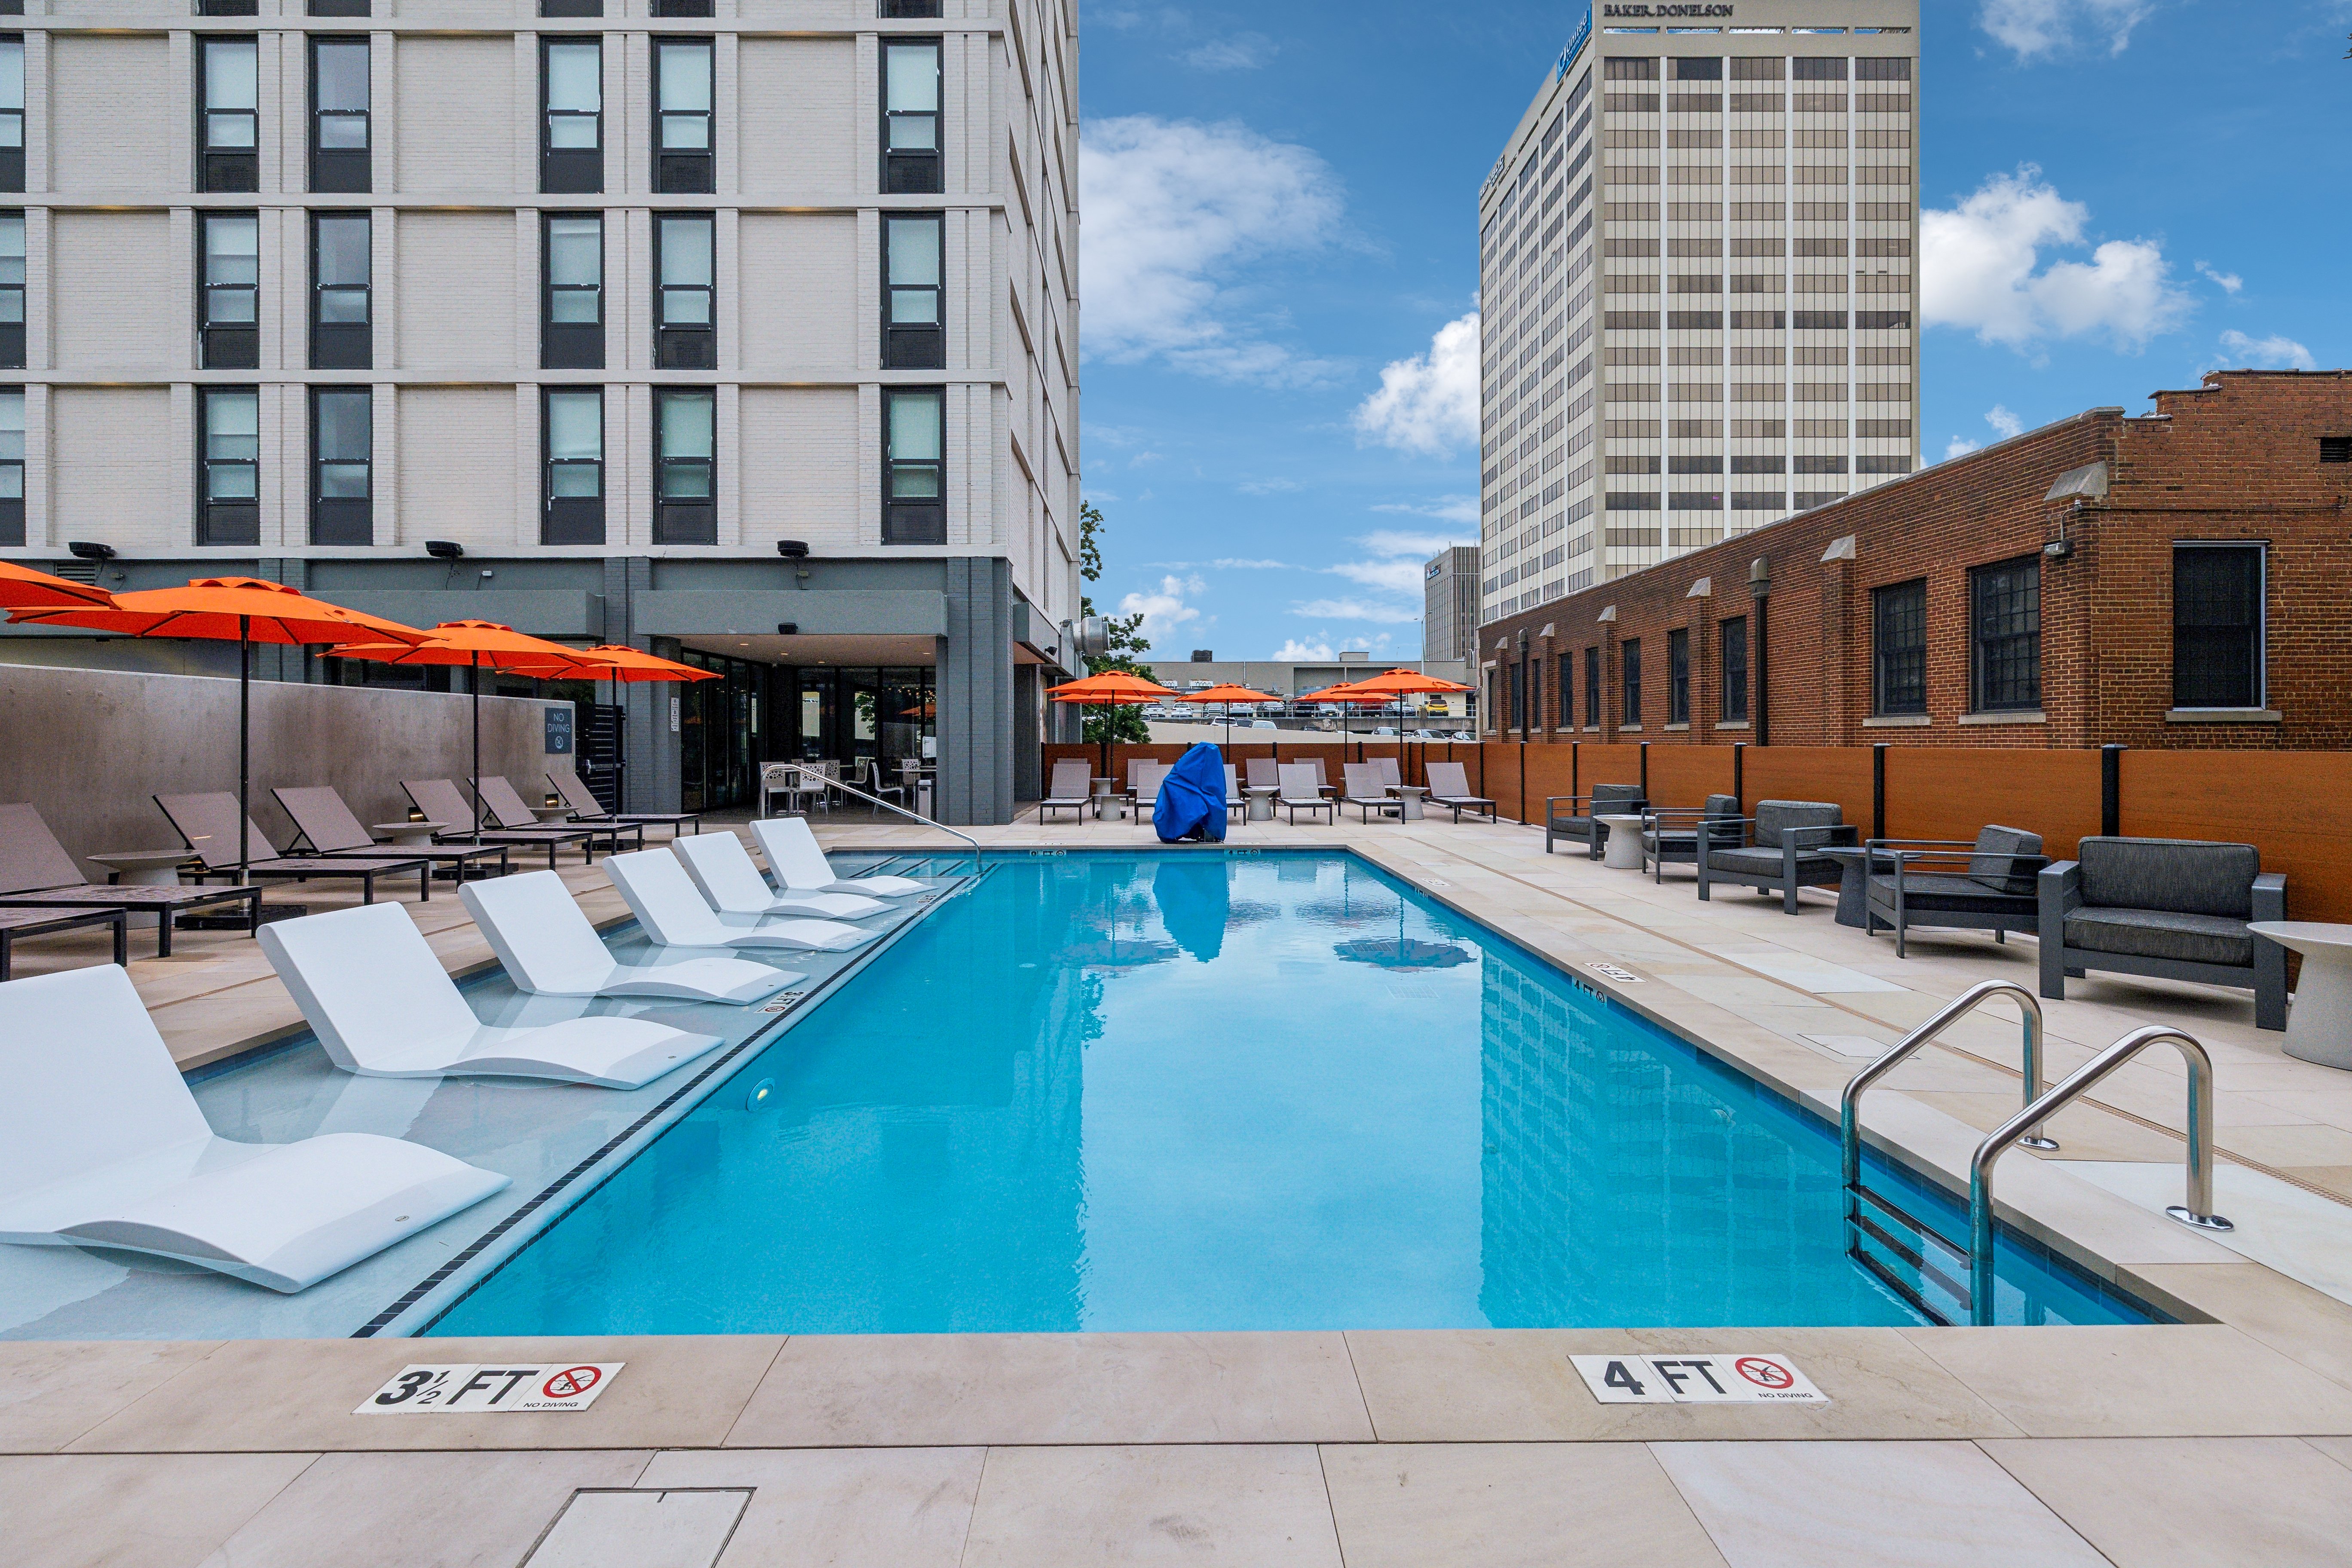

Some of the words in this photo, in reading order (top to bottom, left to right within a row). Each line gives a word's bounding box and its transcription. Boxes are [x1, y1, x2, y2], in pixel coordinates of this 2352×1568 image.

[1604, 4, 1655, 17] BAKER
[1657, 4, 1734, 17] DONELSON
[1566, 11, 1587, 53] United
[1479, 154, 1504, 199] REPUBLIC
[547, 723, 571, 733] DIVING
[553, 713, 564, 722] NO
[1574, 980, 1580, 990] 4
[445, 1370, 540, 1405] FT
[1603, 1360, 1646, 1395] 4
[1651, 1360, 1727, 1394] FT
